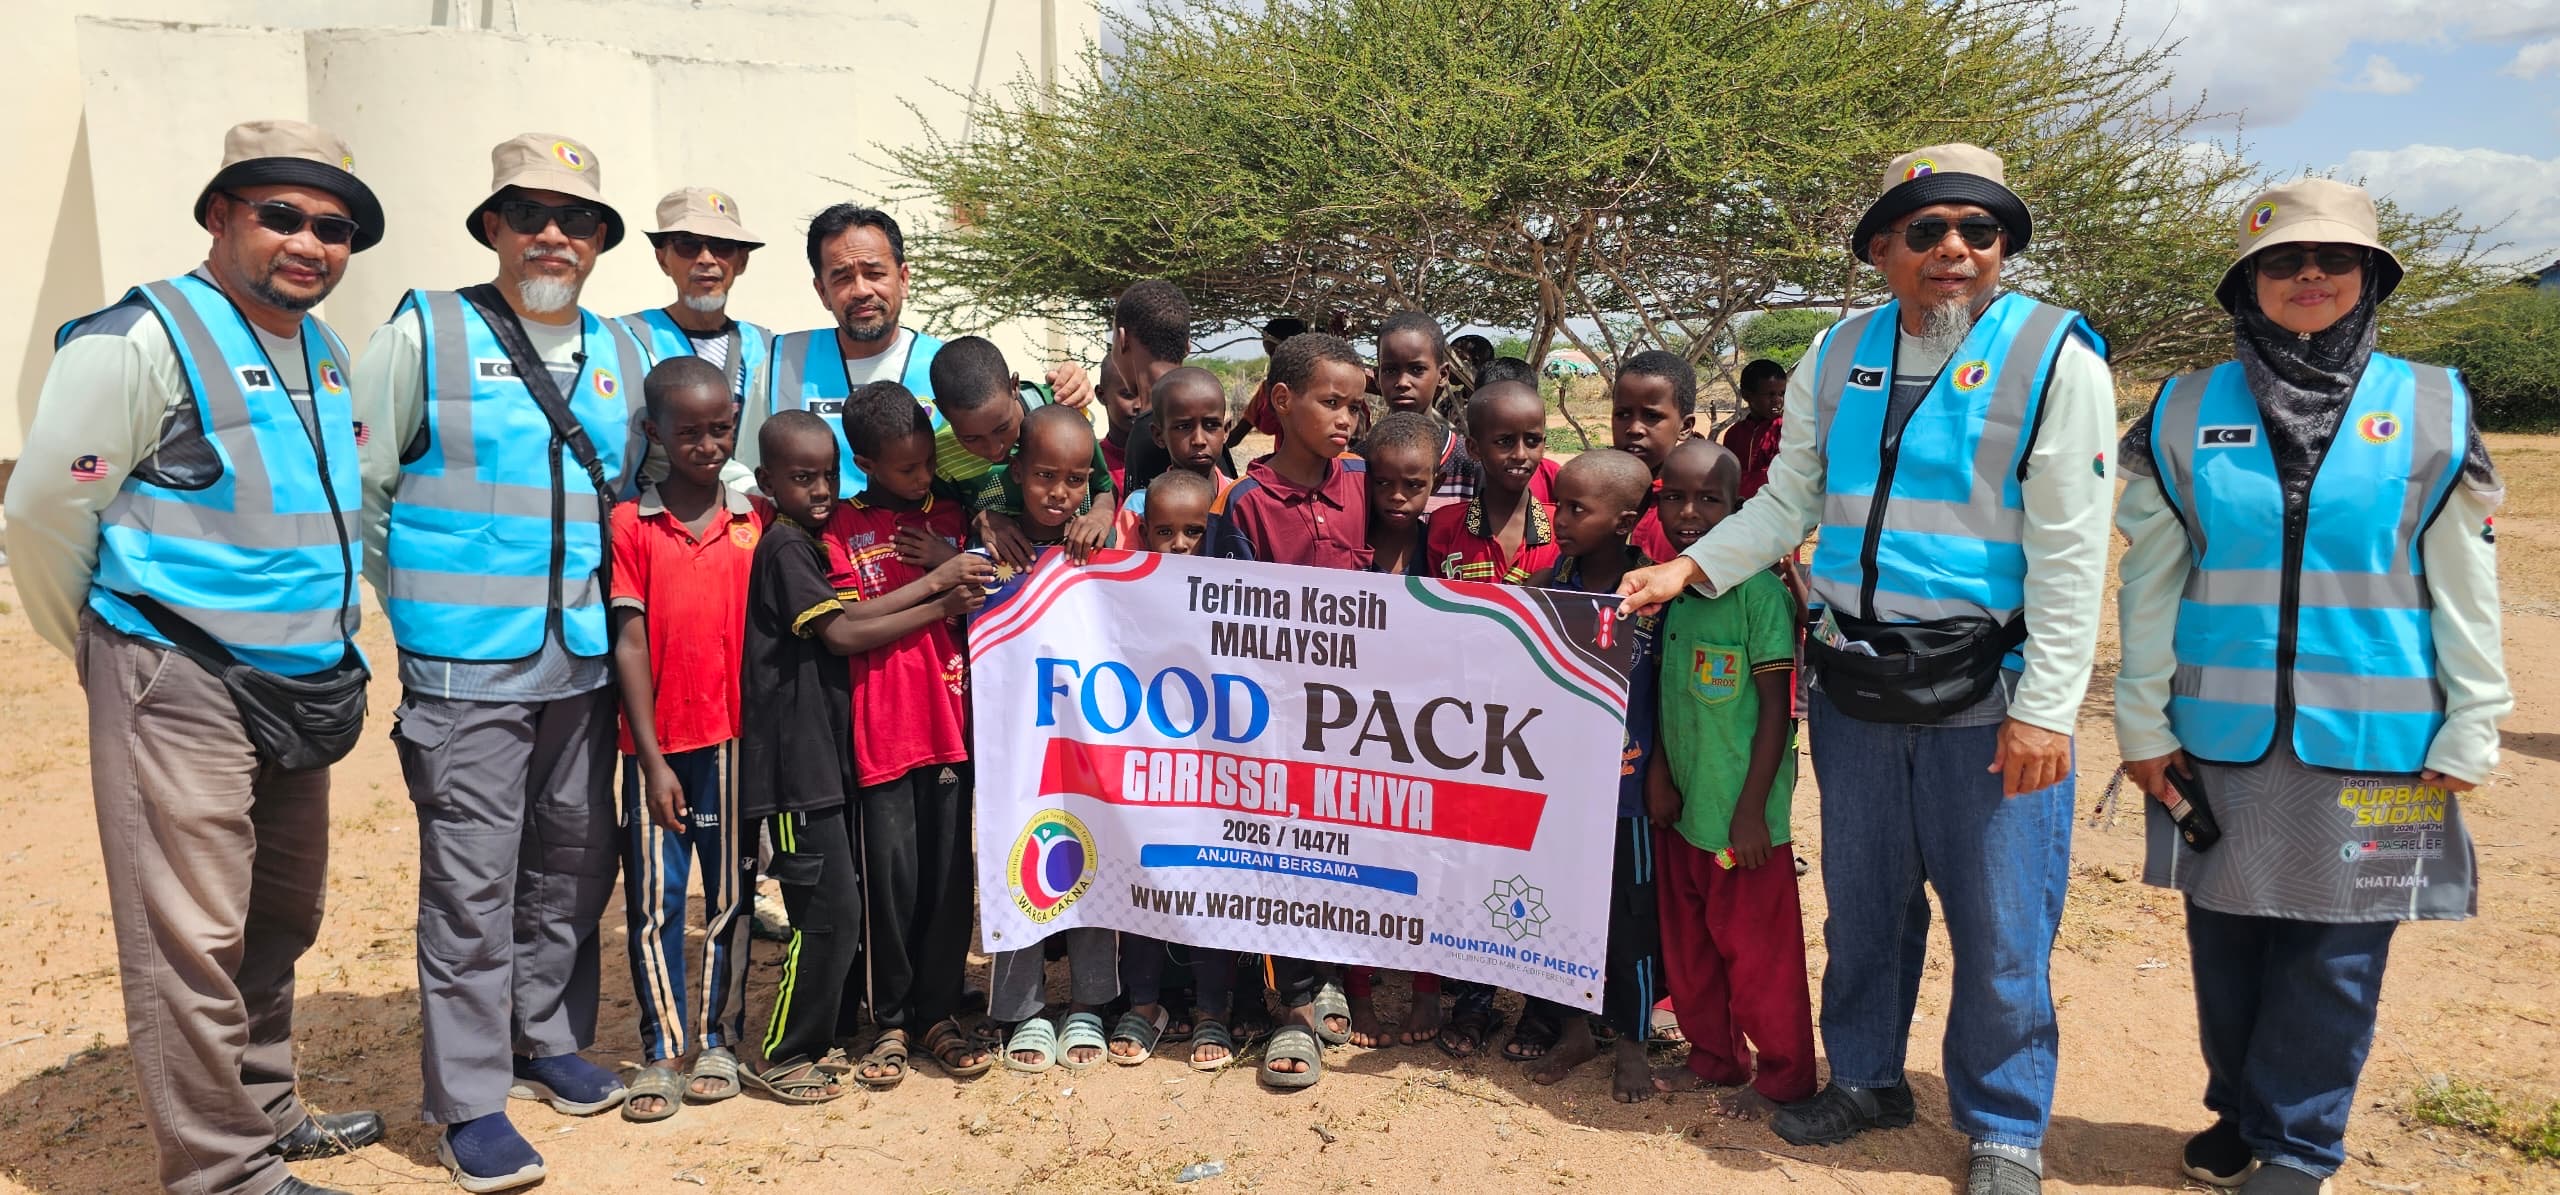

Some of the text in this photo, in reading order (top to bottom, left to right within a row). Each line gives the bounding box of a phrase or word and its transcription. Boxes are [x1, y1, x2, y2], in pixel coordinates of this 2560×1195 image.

[1187, 576, 1387, 630] Terima Kasih
[1211, 620, 1358, 669] MALAYSIA
[1035, 657, 1545, 781] FOOD PACK
[1122, 750, 1434, 831] GARISSA, KENYA
[2339, 784, 2447, 809] QURBAN
[2343, 778, 2380, 788] Team
[2354, 804, 2444, 826] SUDAN
[1223, 819, 1350, 856] 2026 / 1447H
[1197, 847, 1359, 879] ANJURAN BERSAMA
[2355, 875, 2429, 889] KHATIJAH
[1018, 881, 1090, 922] WARGA CAKNA
[1131, 884, 1424, 946] www.wargacakna.org
[1430, 932, 1599, 981] MOUNTAIN OF MERCY
[1452, 951, 1486, 963] HELPING
[1487, 957, 1498, 966] TO
[1528, 968, 1576, 987] DIFFERENCE
[1972, 1140, 2027, 1158] M.CLASS
